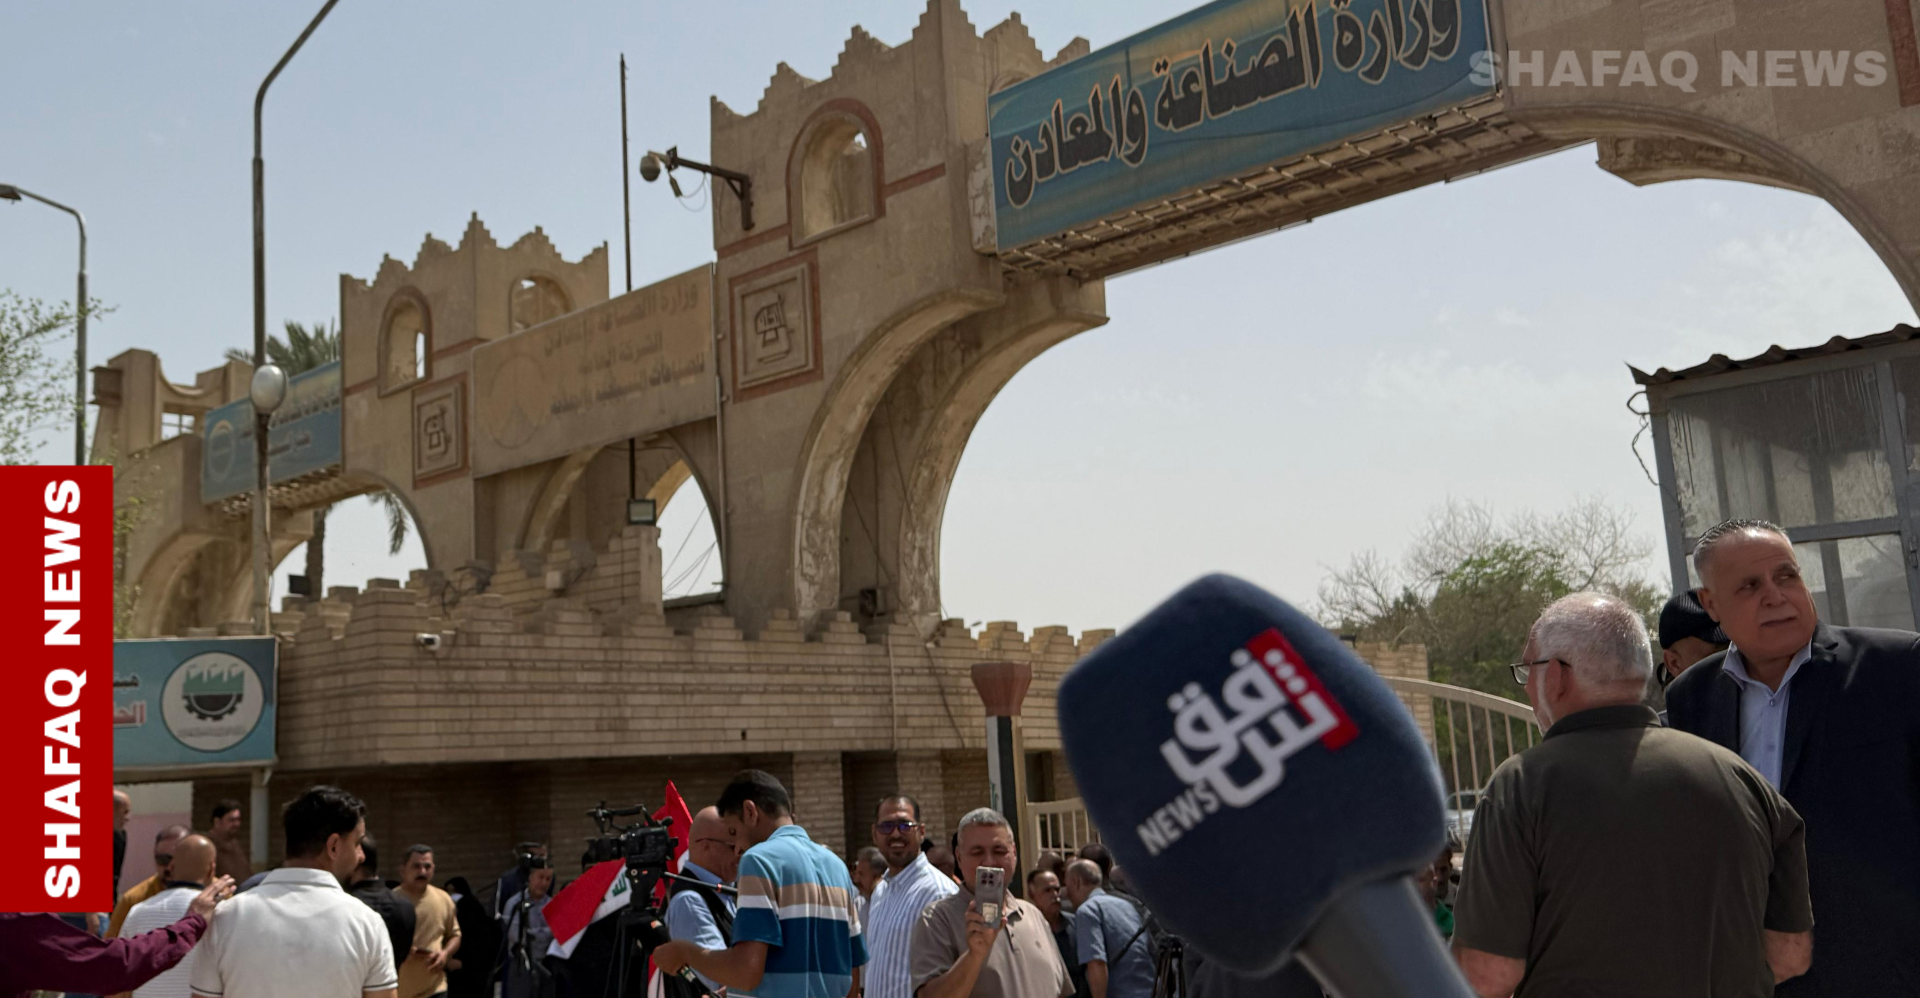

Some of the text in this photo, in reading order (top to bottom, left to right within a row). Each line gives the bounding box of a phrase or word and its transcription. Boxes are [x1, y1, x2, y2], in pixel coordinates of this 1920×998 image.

[1152, 0, 1323, 133] الصناعة
[1005, 73, 1149, 209] والمعادن
[1136, 778, 1221, 856] NEWS
